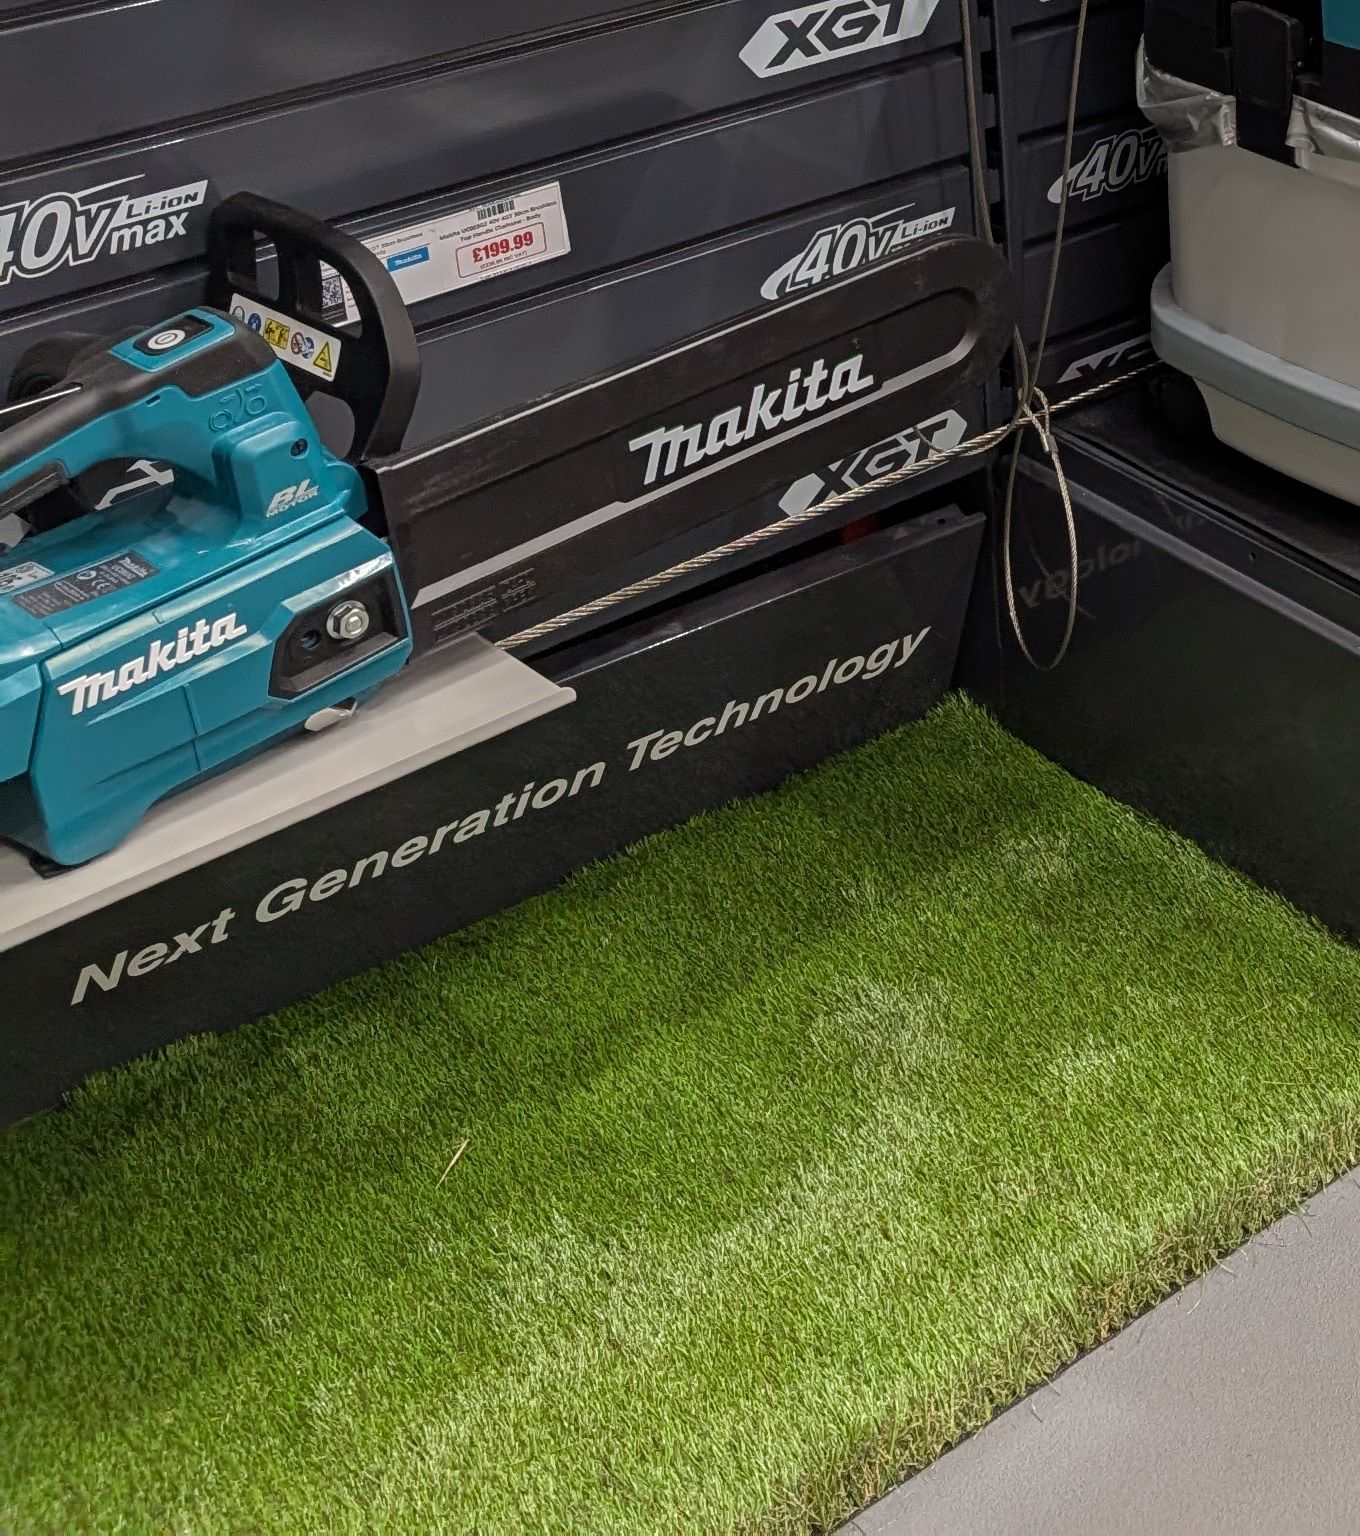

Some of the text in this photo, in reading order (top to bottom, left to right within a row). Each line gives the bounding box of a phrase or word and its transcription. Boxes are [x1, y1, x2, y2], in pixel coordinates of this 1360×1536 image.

[109, 211, 189, 255] max
[471, 230, 534, 264] £199.99
[628, 353, 876, 486] Makita
[58, 611, 247, 716] Makita
[72, 625, 931, 1006] Next Generation Technology
